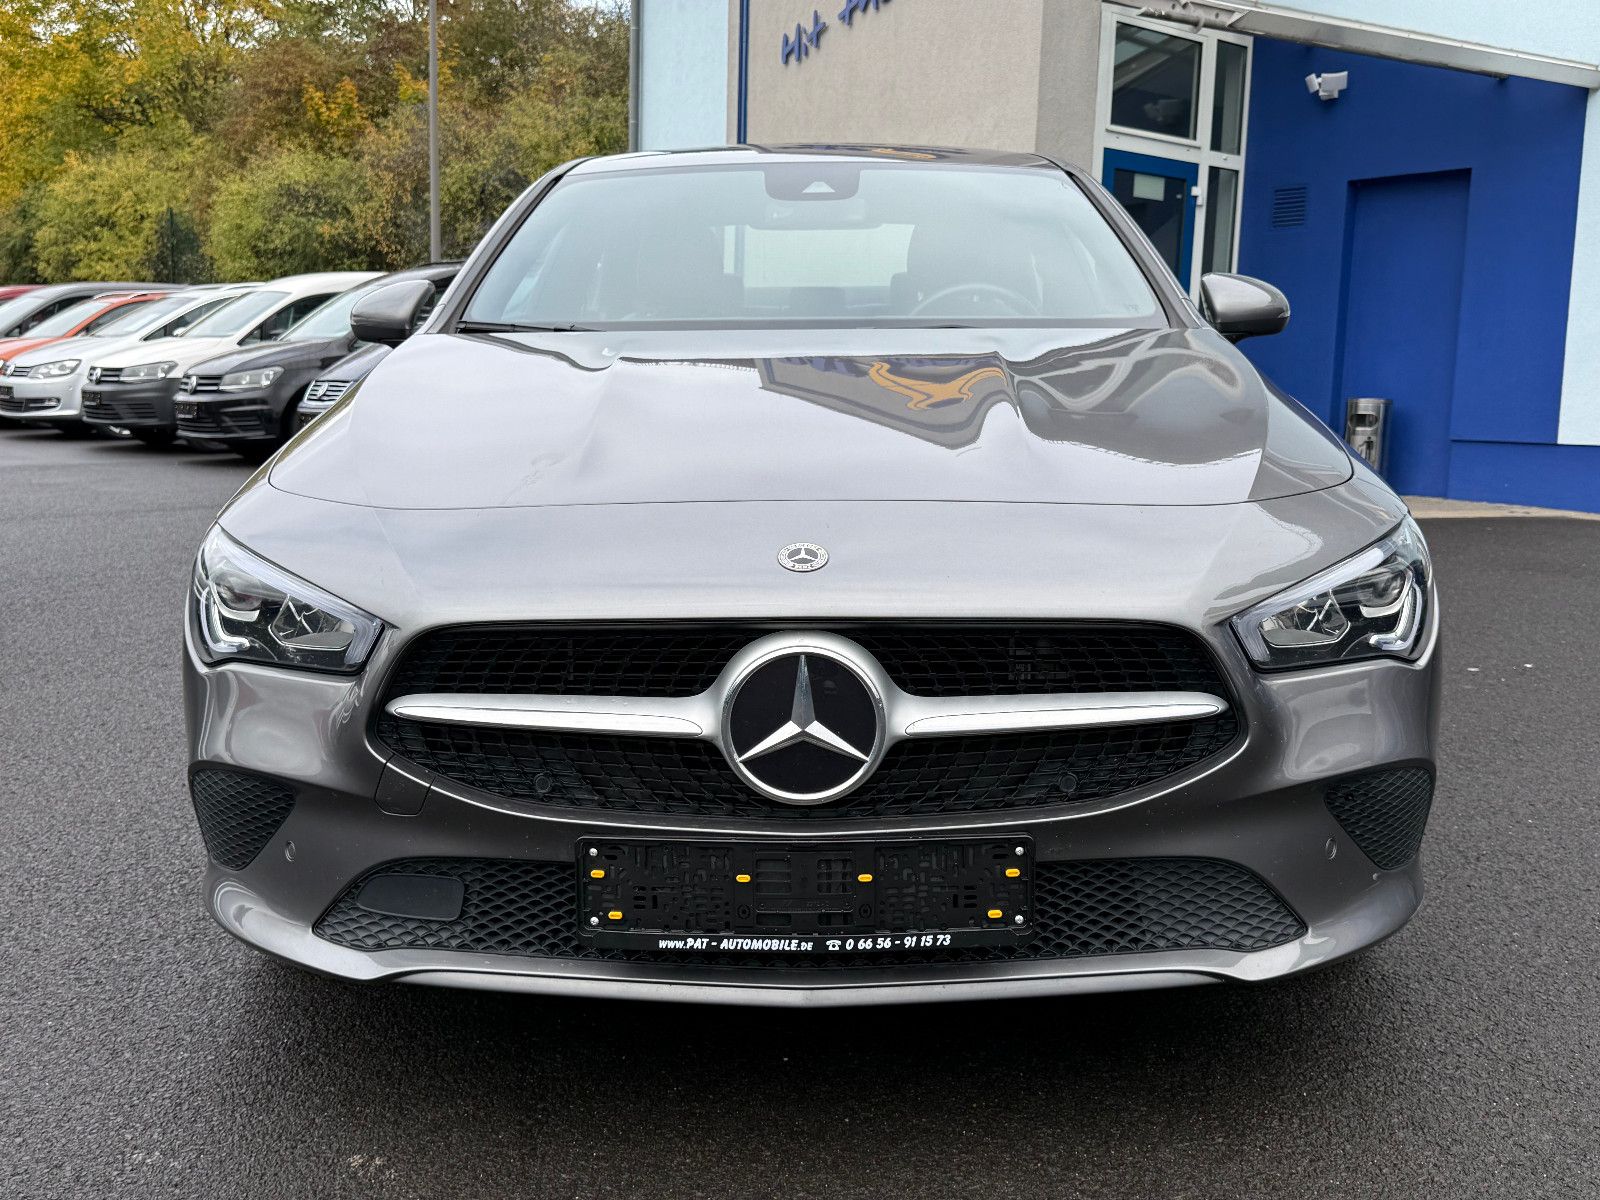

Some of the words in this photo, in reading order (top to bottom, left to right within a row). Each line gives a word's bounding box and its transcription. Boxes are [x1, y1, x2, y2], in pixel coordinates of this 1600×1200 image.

[845, 938, 855, 951] 0
[857, 938, 873, 950] 66
[875, 937, 892, 949] 56
[903, 935, 917, 948] 91
[920, 934, 934, 947] 15
[936, 934, 952, 946] 73
